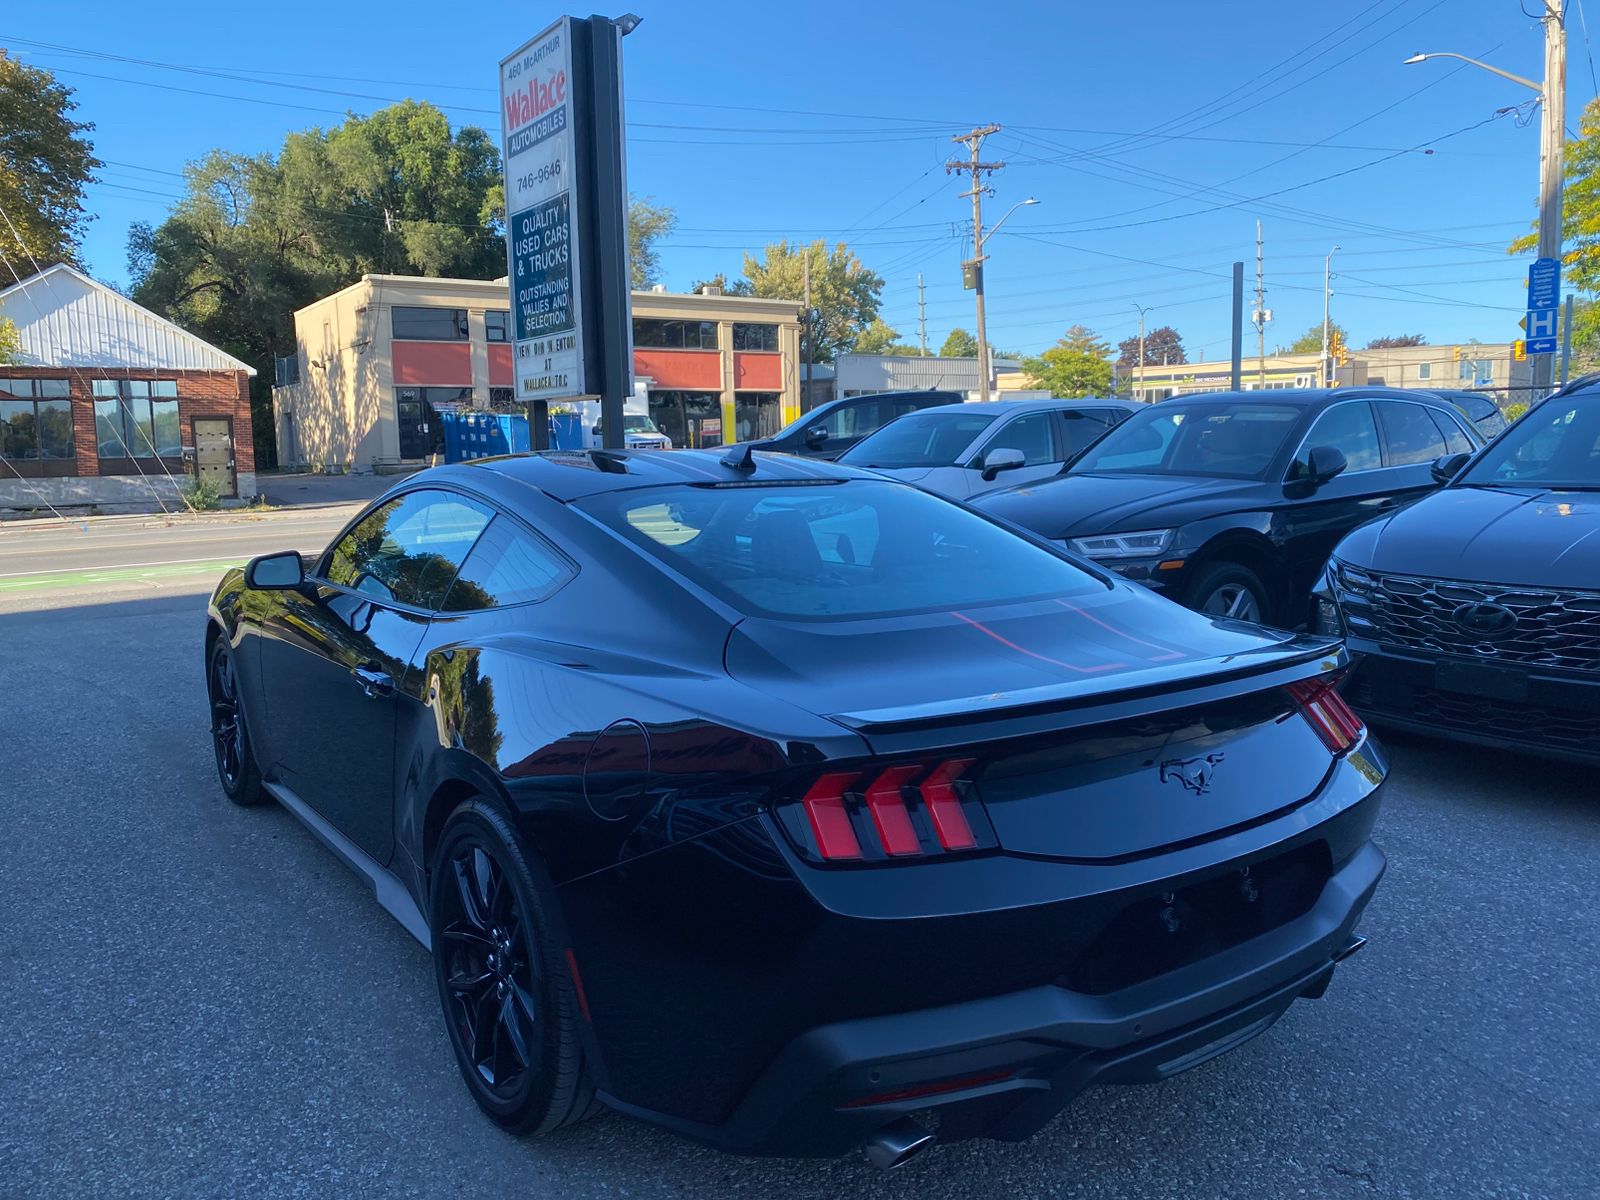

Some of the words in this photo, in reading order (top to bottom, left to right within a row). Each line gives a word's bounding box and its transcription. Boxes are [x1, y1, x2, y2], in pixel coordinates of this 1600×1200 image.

[508, 62, 521, 80] 460
[523, 35, 560, 71] McARTHUR
[505, 70, 566, 131] Wallace
[511, 110, 564, 153] AUTOMOBILES
[517, 159, 561, 193] 746-9646
[522, 205, 559, 235] QUALITY
[516, 235, 540, 257] USED
[544, 222, 569, 247] CARS
[517, 260, 525, 277] &
[529, 243, 569, 273] TRUCKS
[519, 276, 569, 303] OUTSTANDING
[522, 298, 550, 316] VALUES
[552, 293, 568, 310] AND
[526, 310, 566, 331] SELECTION
[1531, 311, 1553, 337] H
[544, 358, 552, 371] AT
